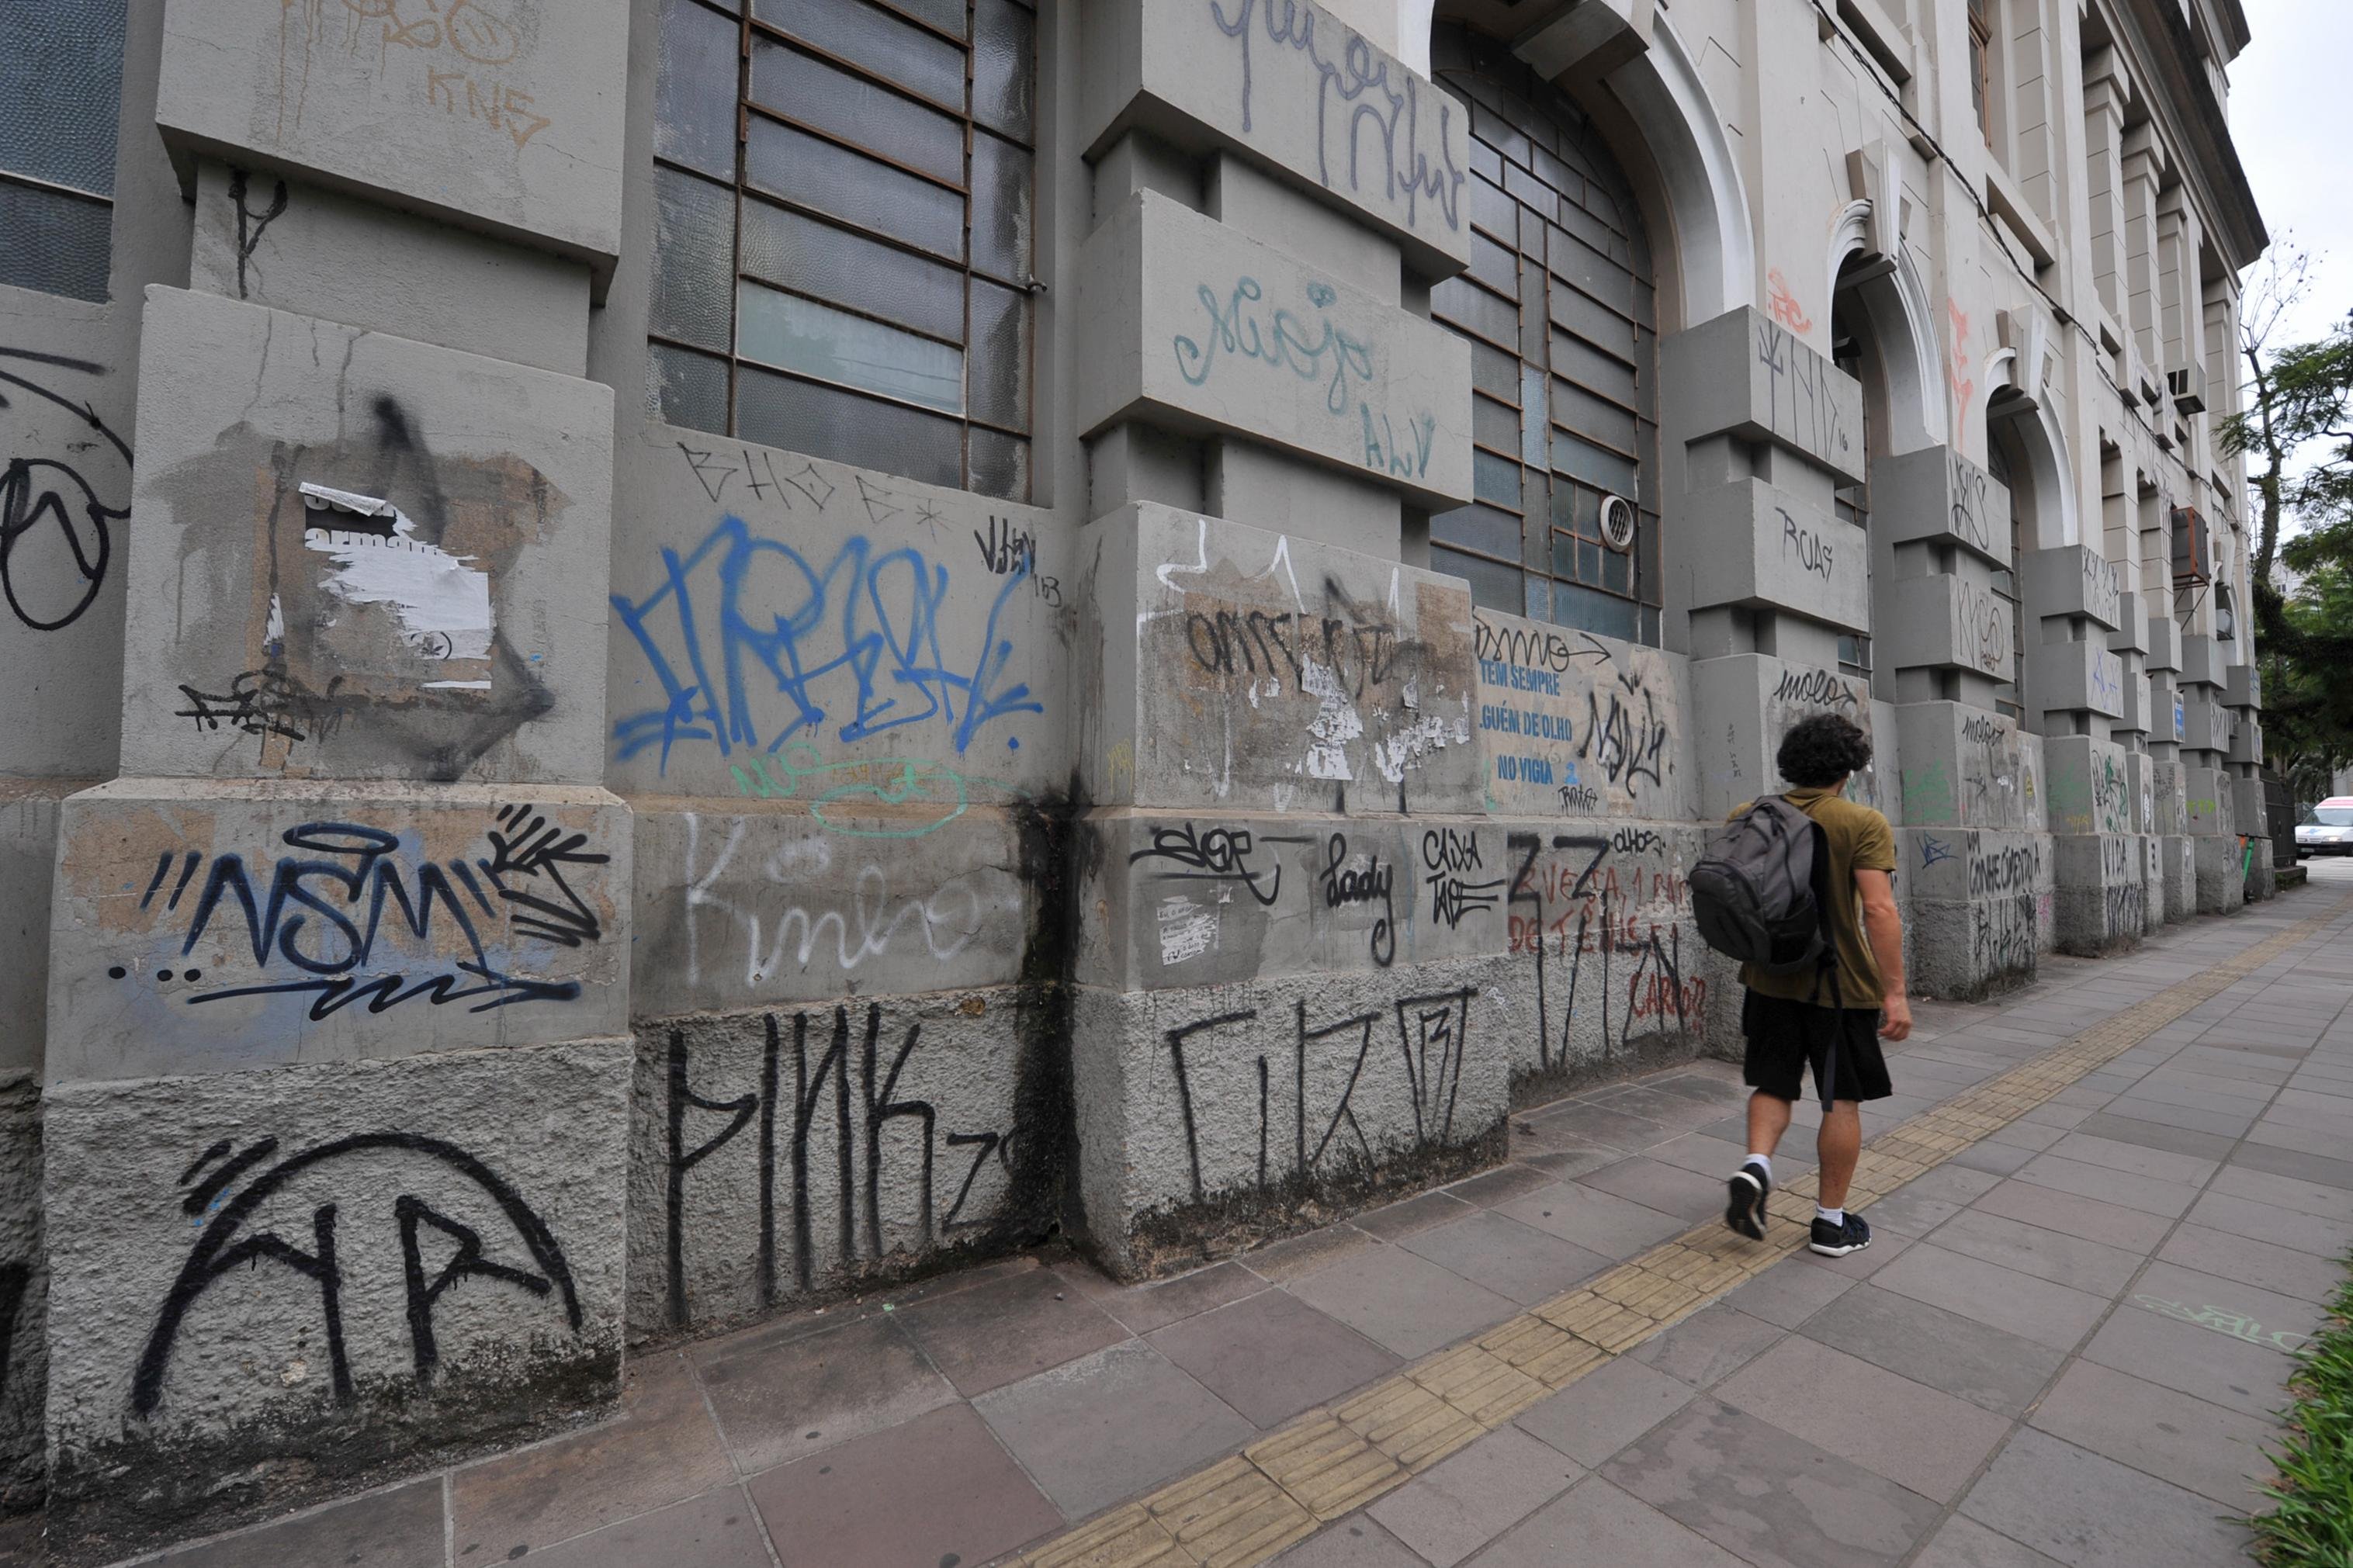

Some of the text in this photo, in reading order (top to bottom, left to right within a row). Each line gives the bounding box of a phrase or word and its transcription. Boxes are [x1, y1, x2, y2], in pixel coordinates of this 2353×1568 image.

[1774, 506, 1833, 583] RUAS
[1479, 659, 1561, 697] TEM SEMPRE
[1523, 711, 1540, 738] DE
[1542, 715, 1573, 742] OLHO
[1497, 754, 1554, 785] NO VIGIA
